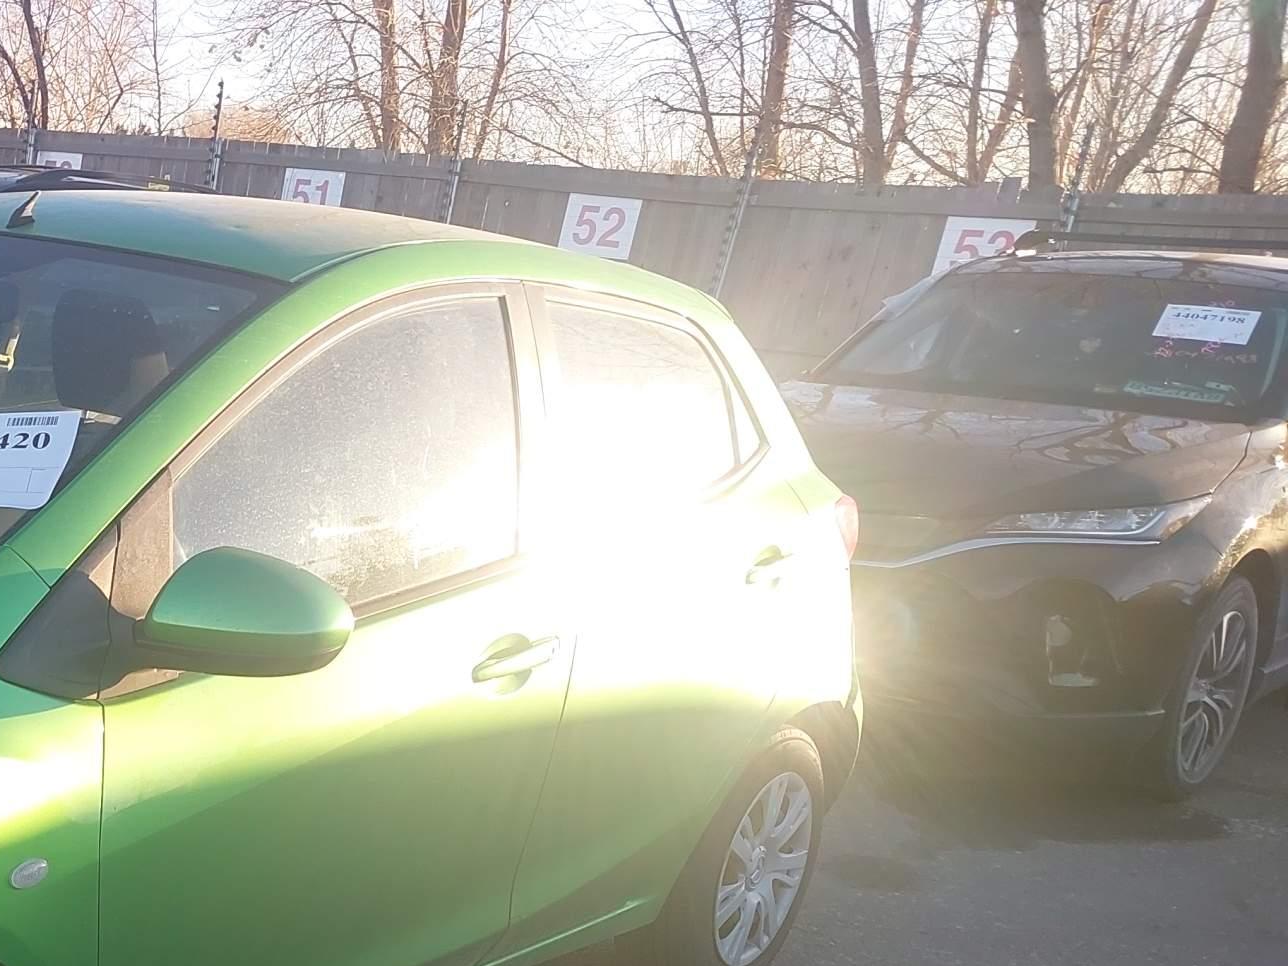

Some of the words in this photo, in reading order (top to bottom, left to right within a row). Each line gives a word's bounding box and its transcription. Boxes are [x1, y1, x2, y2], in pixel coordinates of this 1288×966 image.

[293, 178, 330, 205] 51
[572, 205, 626, 249] 52
[1173, 312, 1247, 324] 44047198
